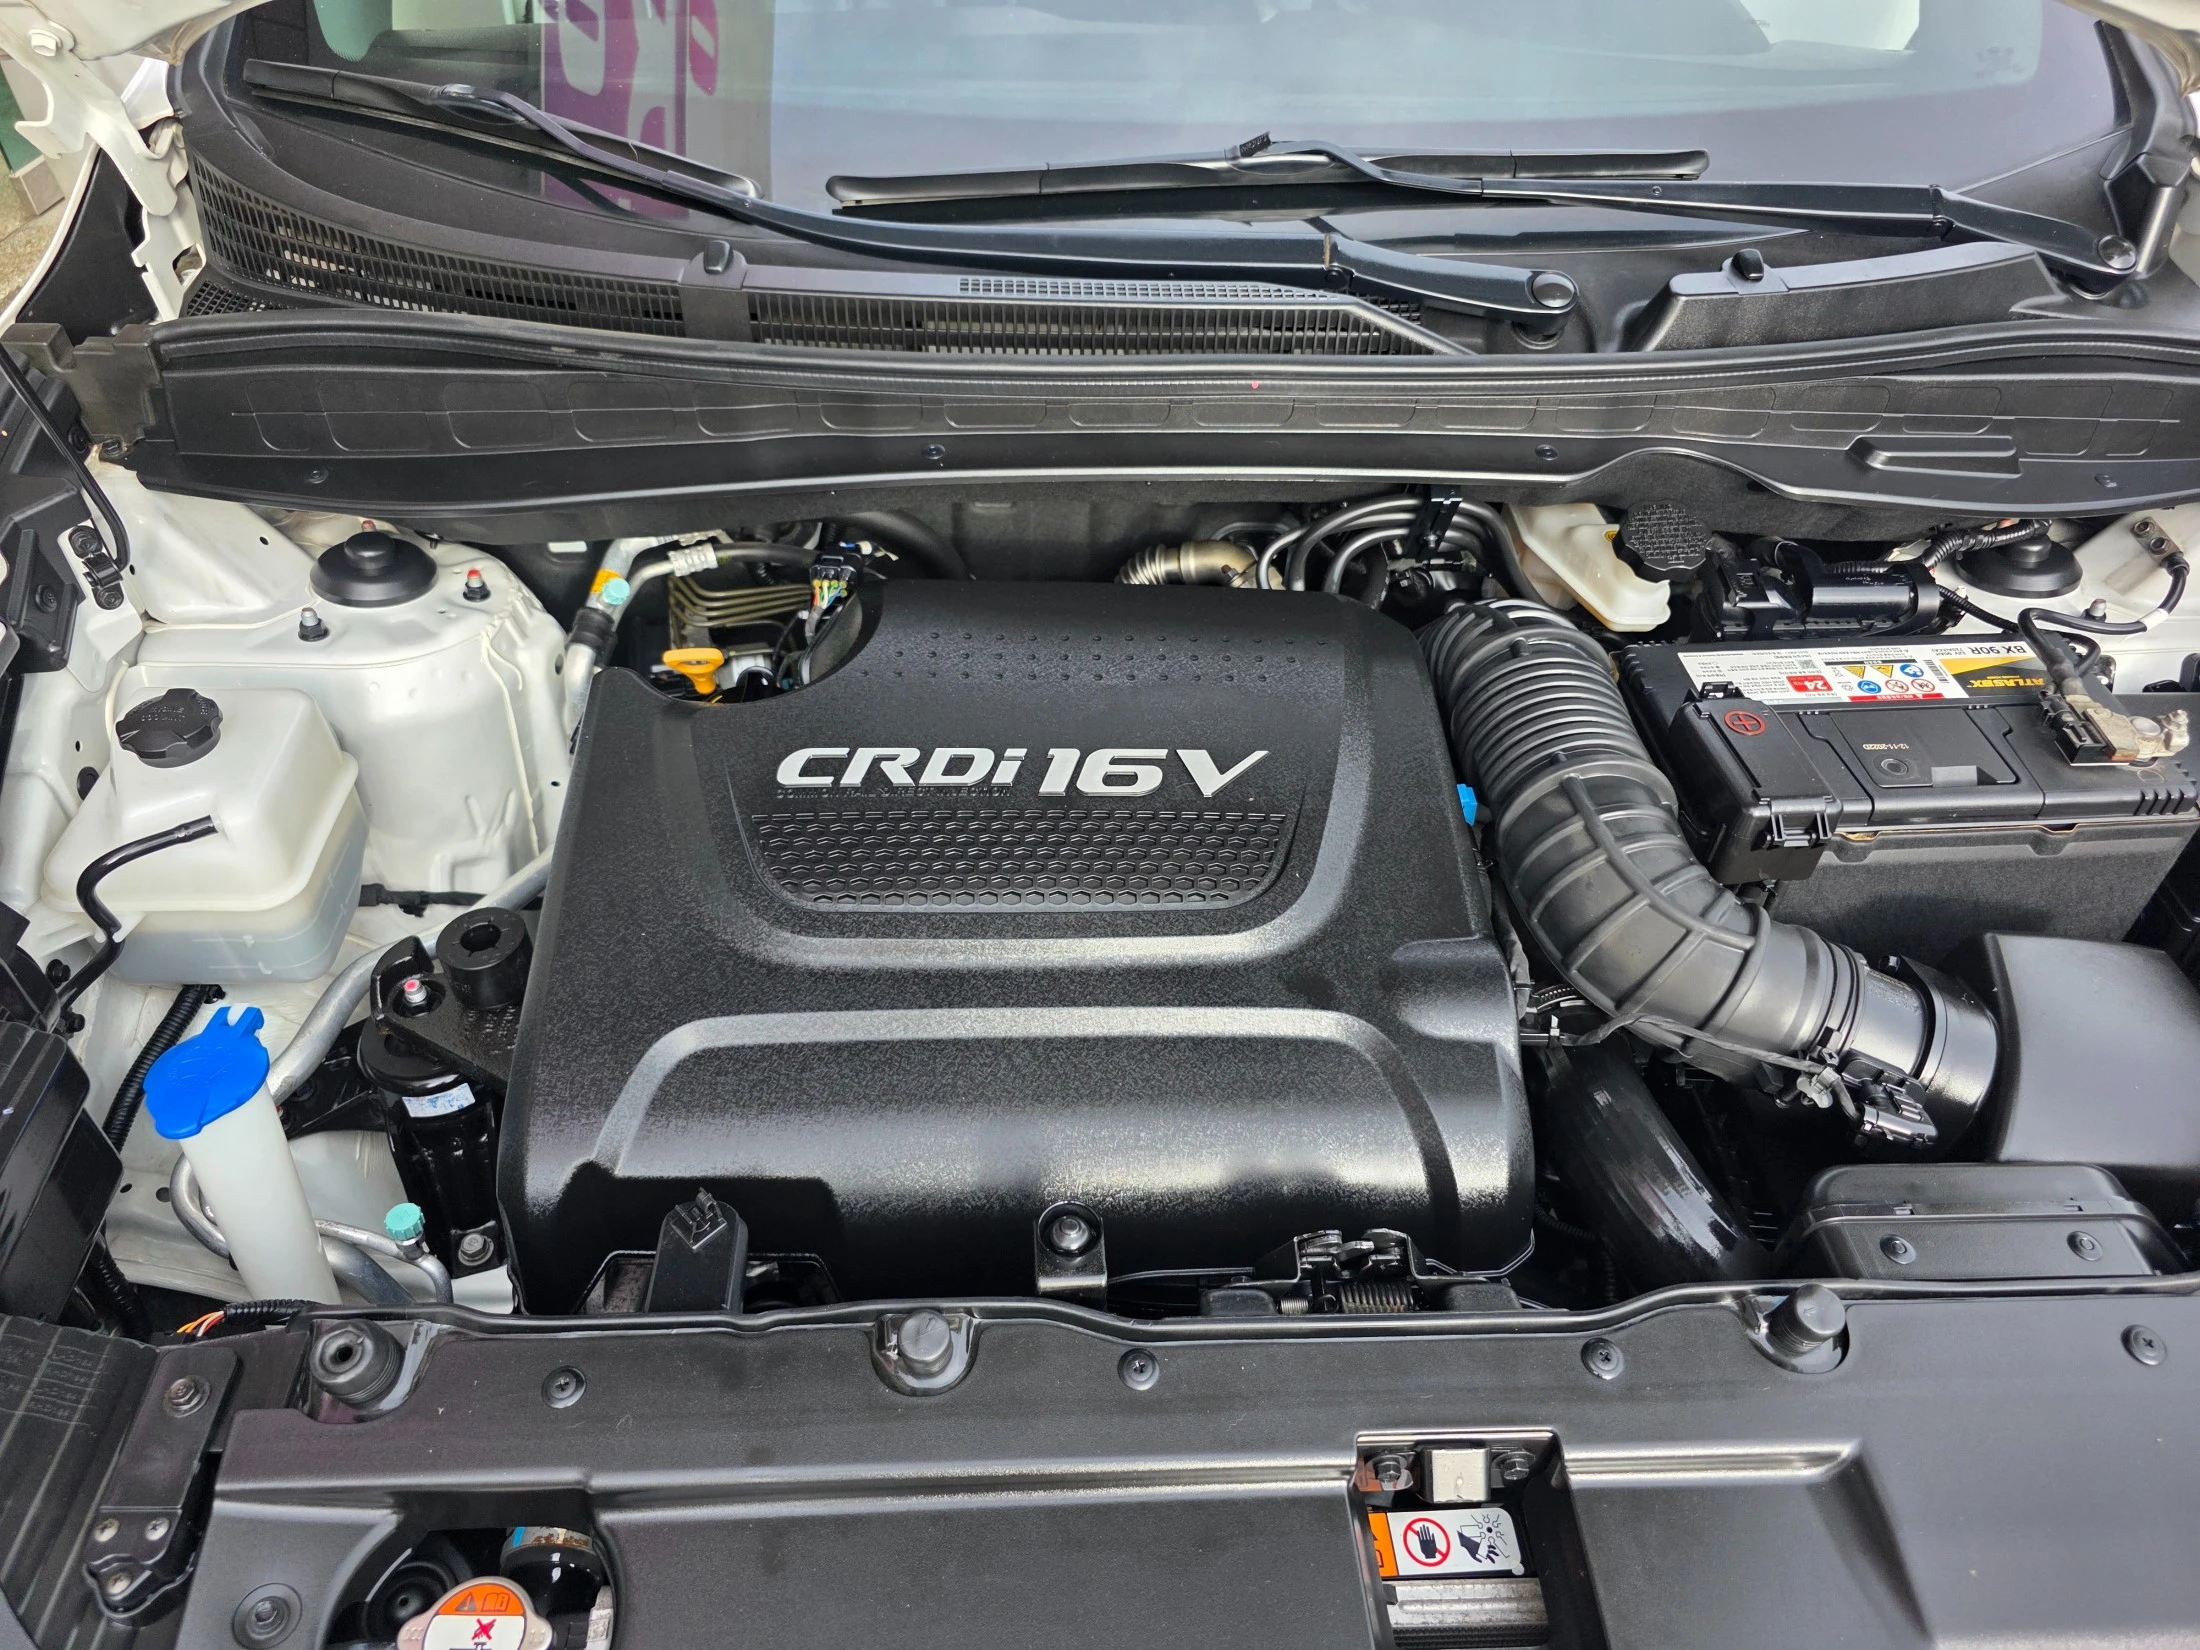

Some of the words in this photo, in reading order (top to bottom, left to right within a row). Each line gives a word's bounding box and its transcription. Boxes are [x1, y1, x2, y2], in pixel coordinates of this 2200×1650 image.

[1968, 646, 2001, 655] 90R
[2001, 645, 2027, 654] BX
[1803, 680, 1827, 691] 24
[1969, 678, 2045, 688] ATLASBX
[775, 746, 1028, 788] CRDi
[1037, 747, 1269, 798] 16V
